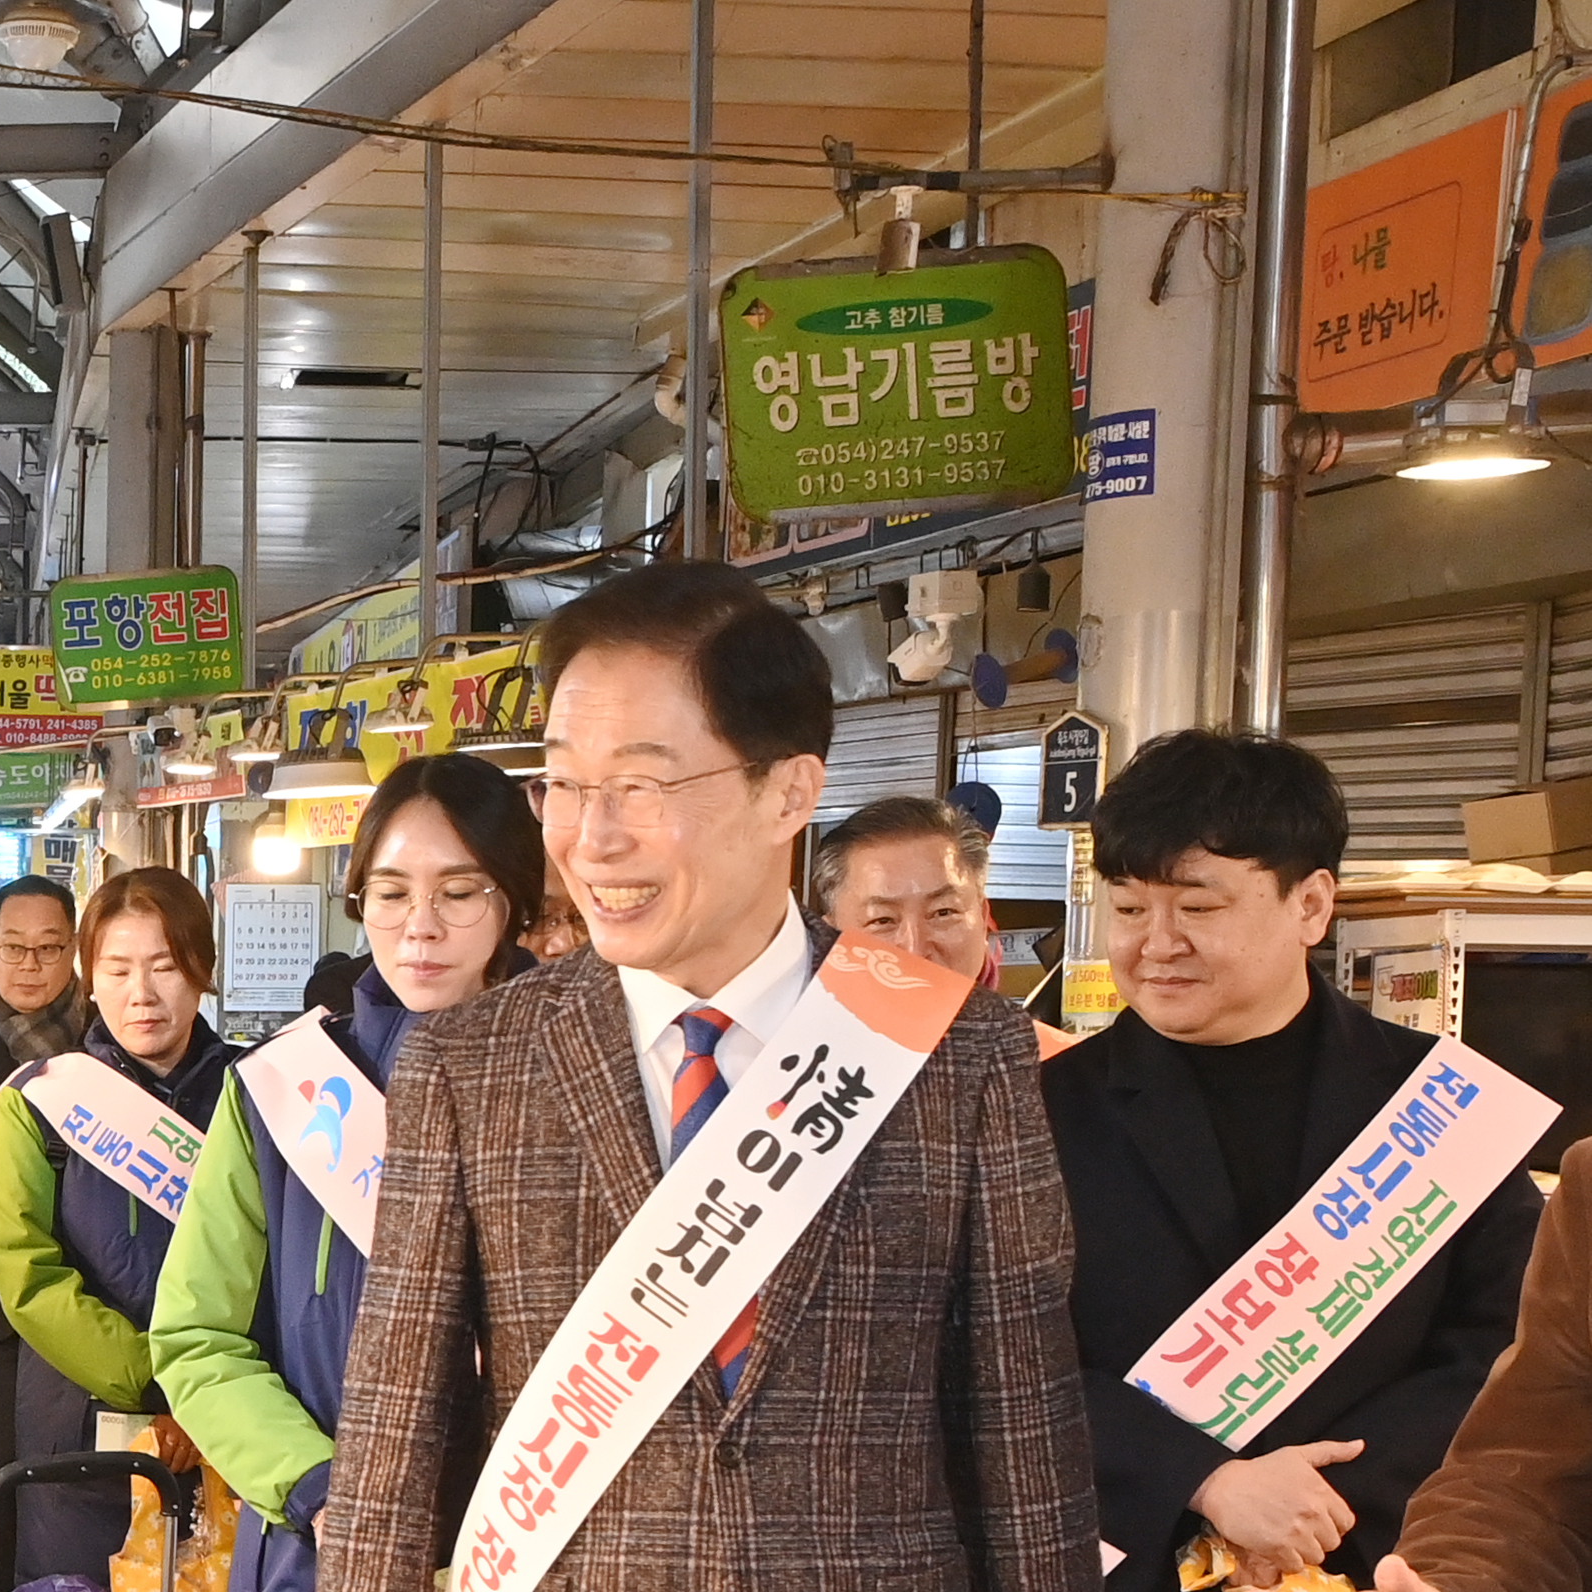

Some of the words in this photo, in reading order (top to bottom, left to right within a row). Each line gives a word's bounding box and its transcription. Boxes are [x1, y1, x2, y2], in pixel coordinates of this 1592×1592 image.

[1352, 226, 1392, 275] 나물
[845, 309, 881, 331] 고추
[889, 303, 945, 328] 참기름
[1313, 313, 1352, 363] 주문
[1358, 282, 1444, 347] 받습니다.
[753, 333, 1040, 433] 영남기름방
[798, 459, 1007, 496] 010-3131-9537
[62, 588, 230, 651] 포항전집
[91, 649, 231, 672] 054-252-7876
[92, 666, 232, 689] 010-6381-7958
[47, 718, 98, 731] 241-4385
[1063, 771, 1078, 813] 5
[270, 888, 276, 902] 1
[1312, 1061, 1481, 1241] 전통시장
[630, 1177, 763, 1329] 넘치는
[1306, 1179, 1458, 1339] 지역경제
[1159, 1232, 1319, 1389] 장보기
[1194, 1329, 1319, 1443] 살리기
[499, 1310, 660, 1532] 전통시장
